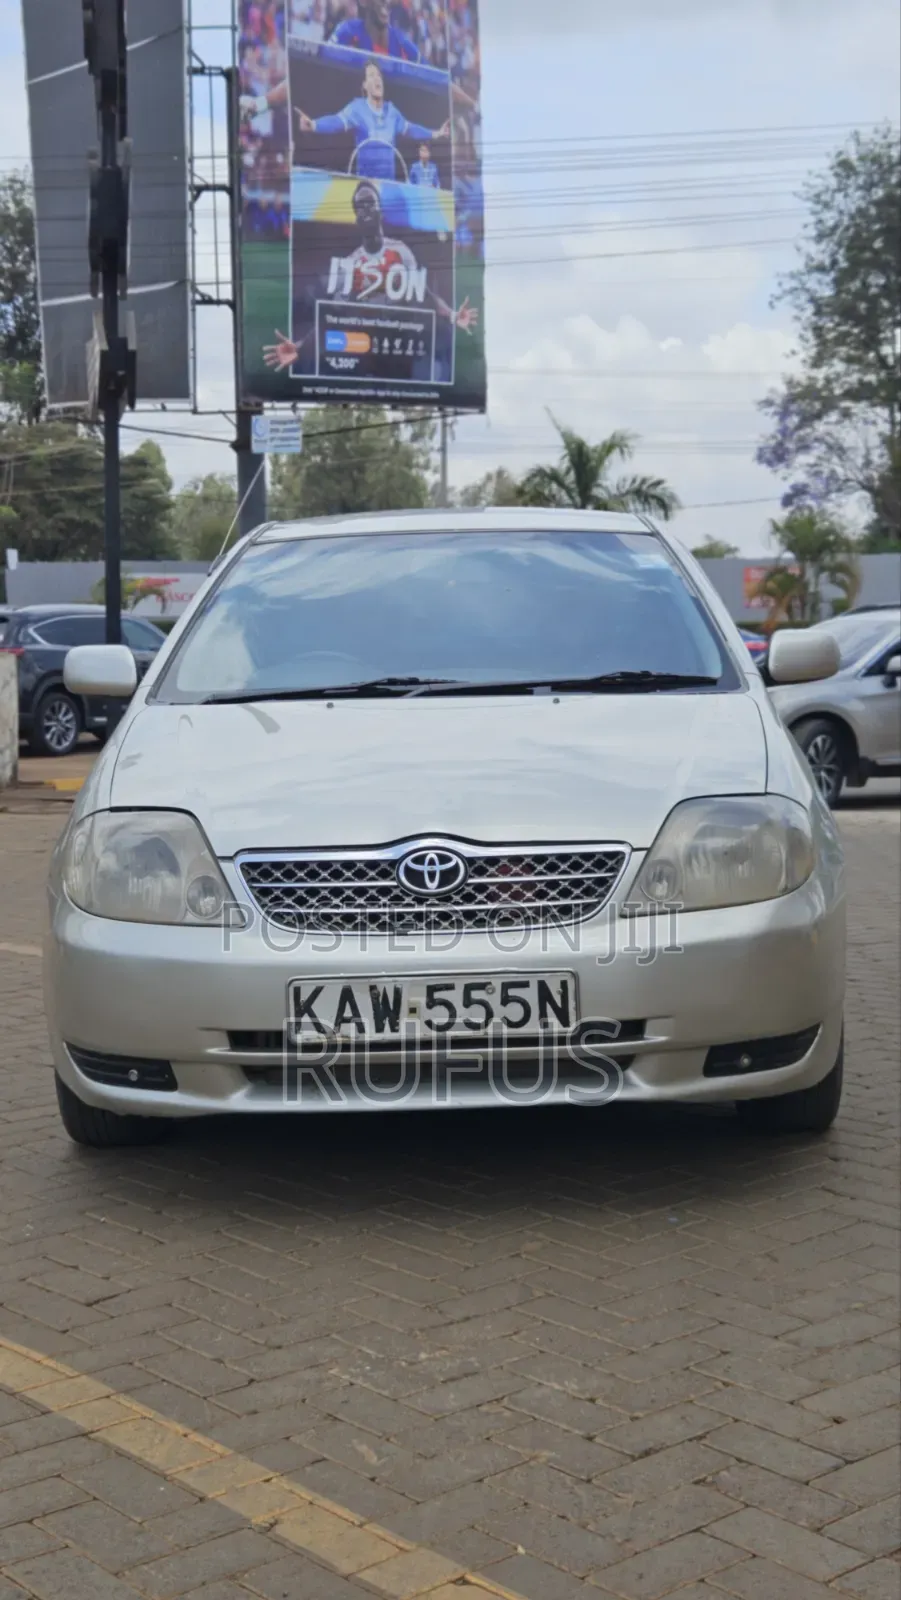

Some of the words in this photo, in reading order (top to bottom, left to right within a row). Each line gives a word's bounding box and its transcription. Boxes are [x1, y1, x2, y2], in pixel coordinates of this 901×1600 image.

[386, 263, 427, 303] ON
[293, 983, 402, 1037] KAW
[424, 979, 573, 1032] 555N
